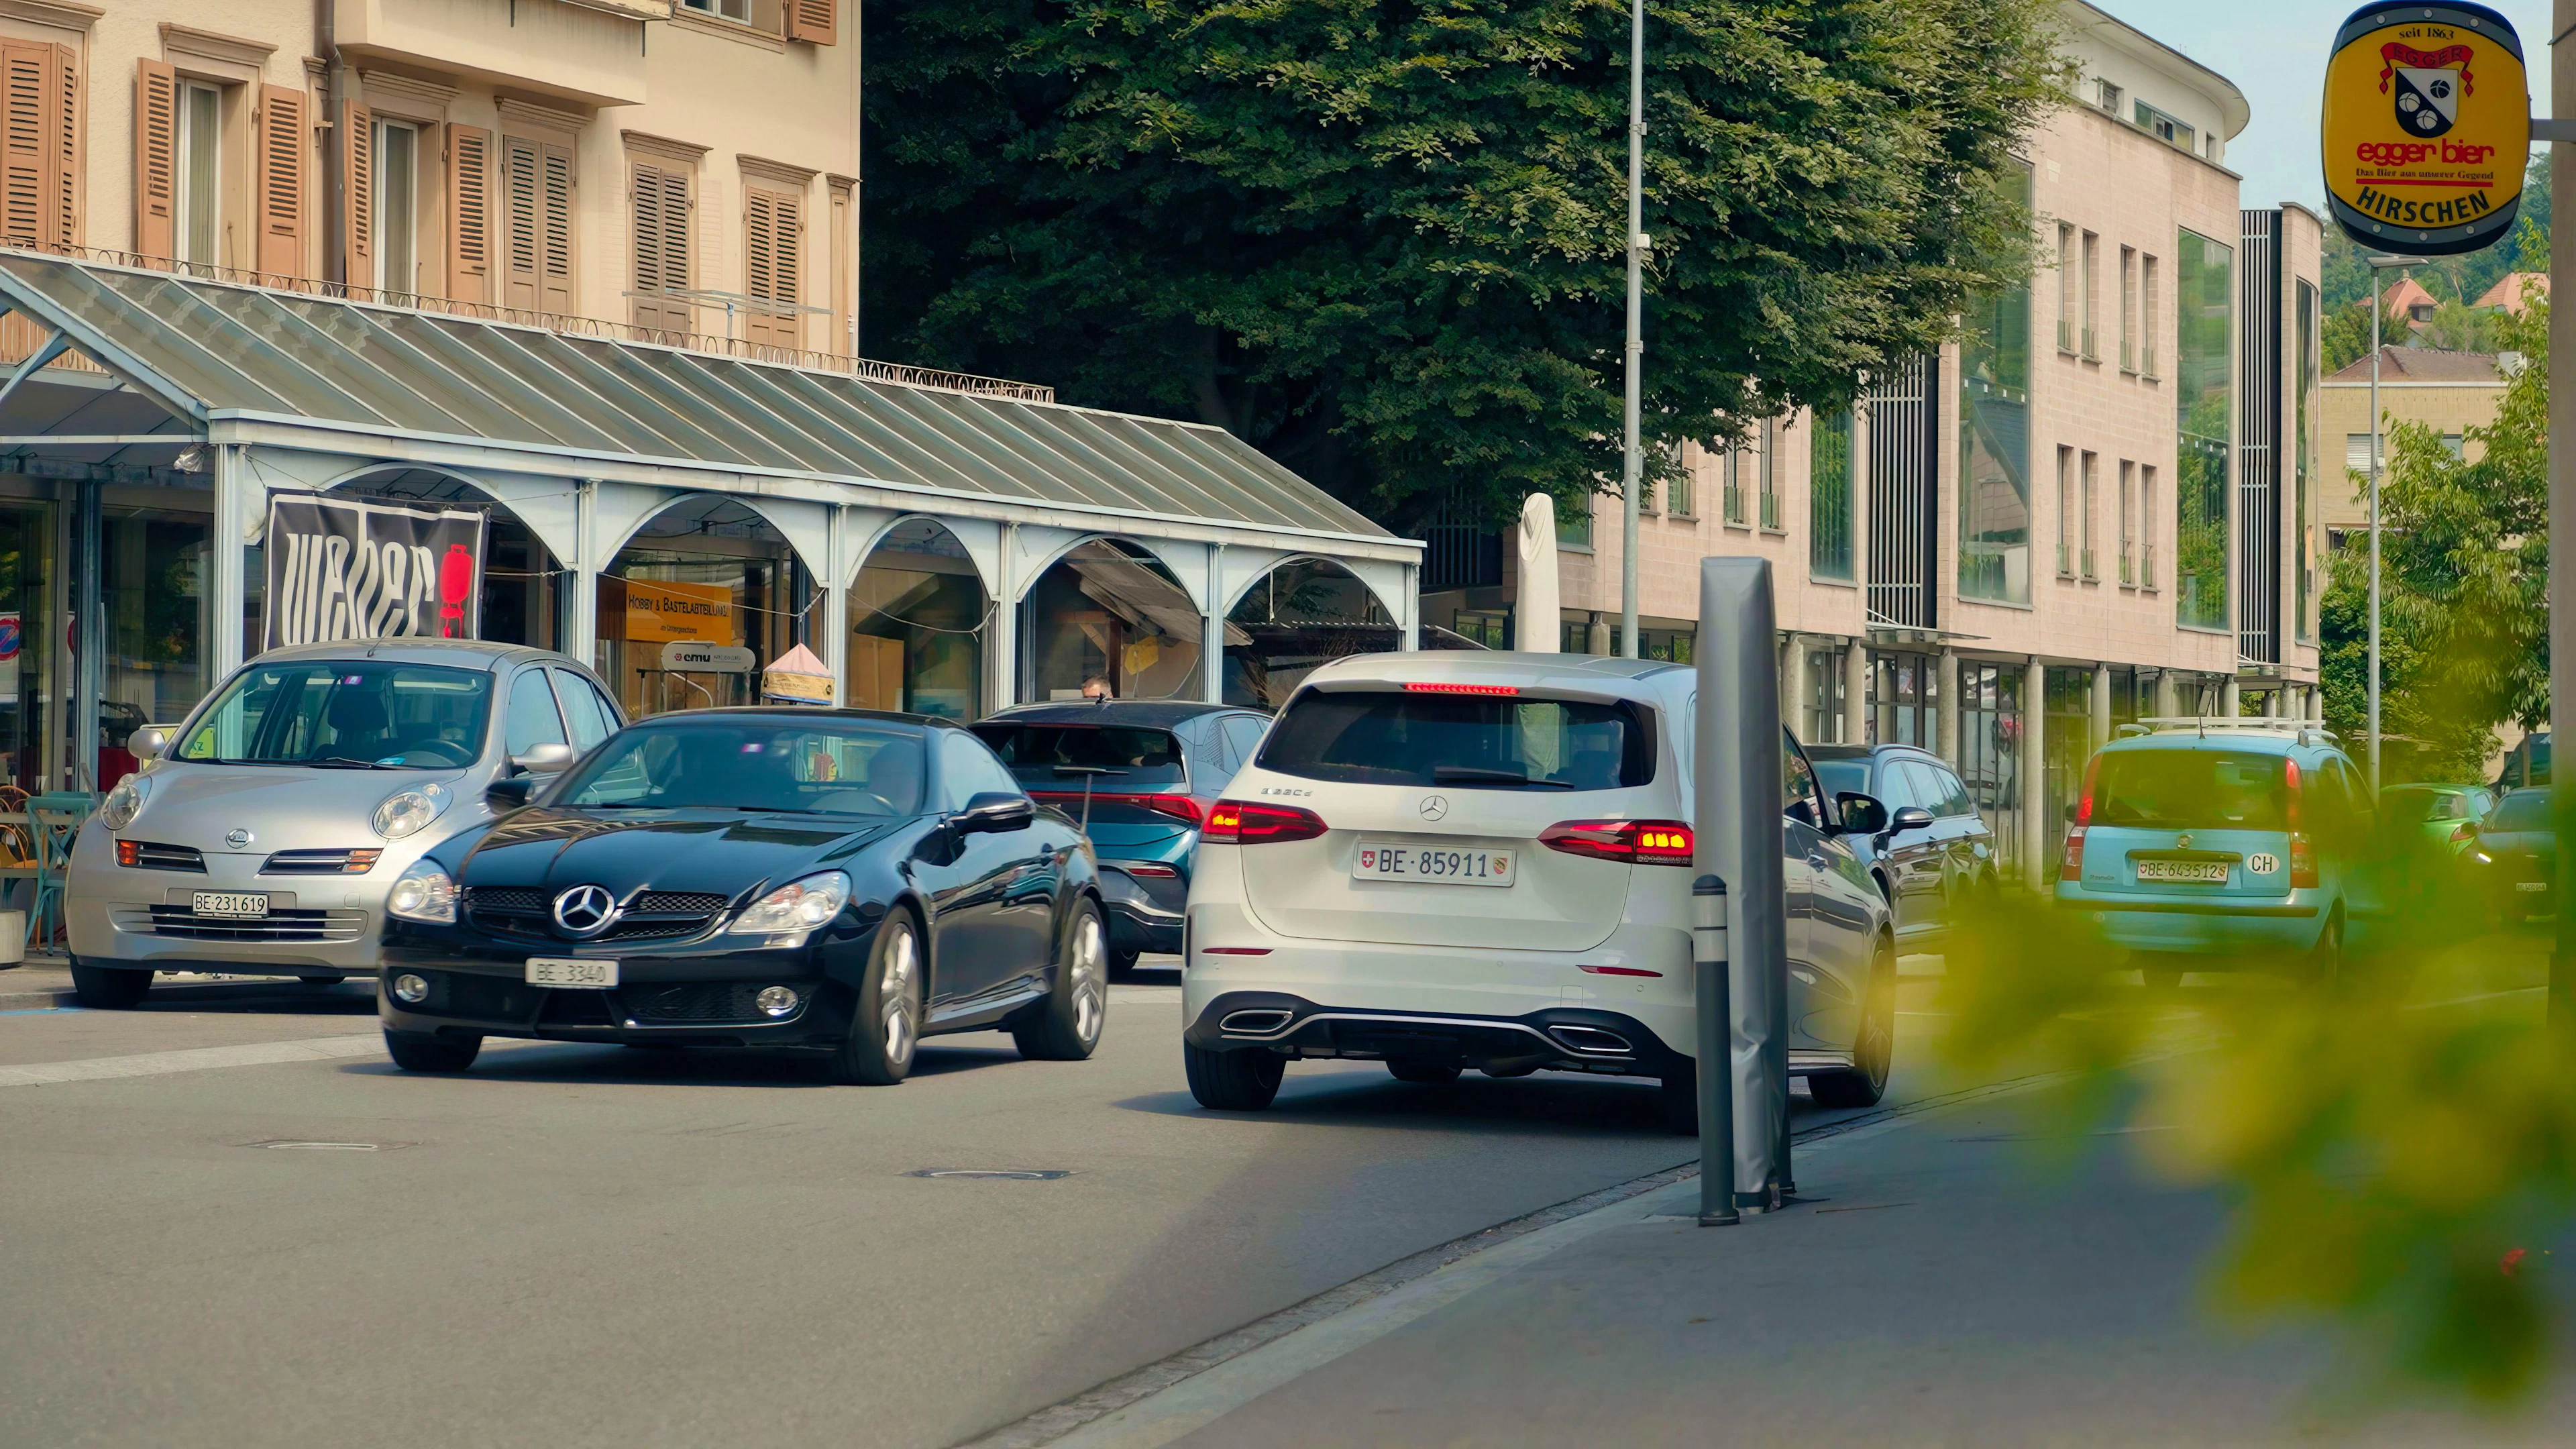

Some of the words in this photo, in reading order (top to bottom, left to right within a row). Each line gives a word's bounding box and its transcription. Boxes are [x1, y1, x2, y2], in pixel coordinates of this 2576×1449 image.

[2398, 28, 2420, 38] seit
[2426, 28, 2454, 40] 1863
[2393, 45, 2463, 66] EGGER
[2357, 142, 2436, 166] egger
[2441, 138, 2495, 164] bier
[2377, 168, 2396, 176] Bier
[2457, 170, 2493, 180] Gegend
[2356, 186, 2490, 223] HIRSCHEN
[2251, 855, 2273, 871] CH
